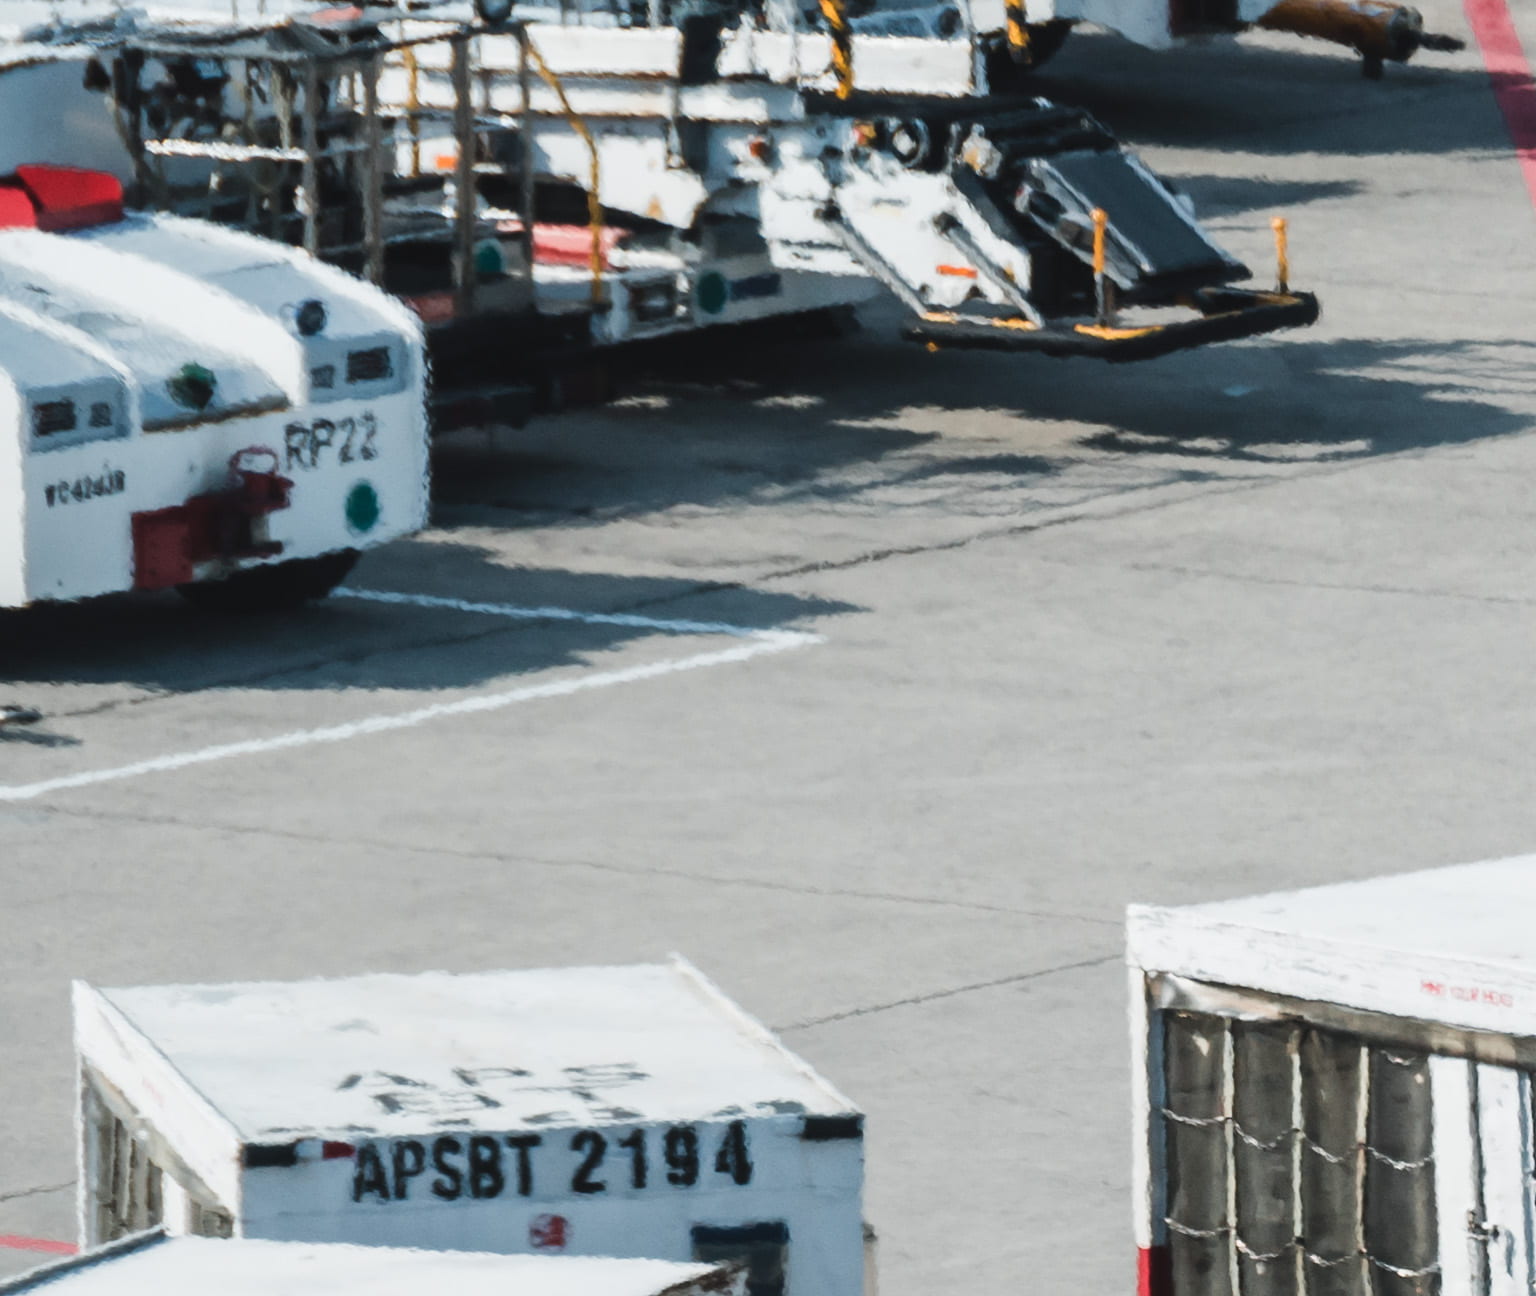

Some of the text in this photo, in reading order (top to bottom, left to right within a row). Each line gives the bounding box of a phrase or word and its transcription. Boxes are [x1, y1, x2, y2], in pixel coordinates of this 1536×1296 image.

[284, 410, 378, 470] RP22
[352, 1118, 754, 1203] APSBT 2194
